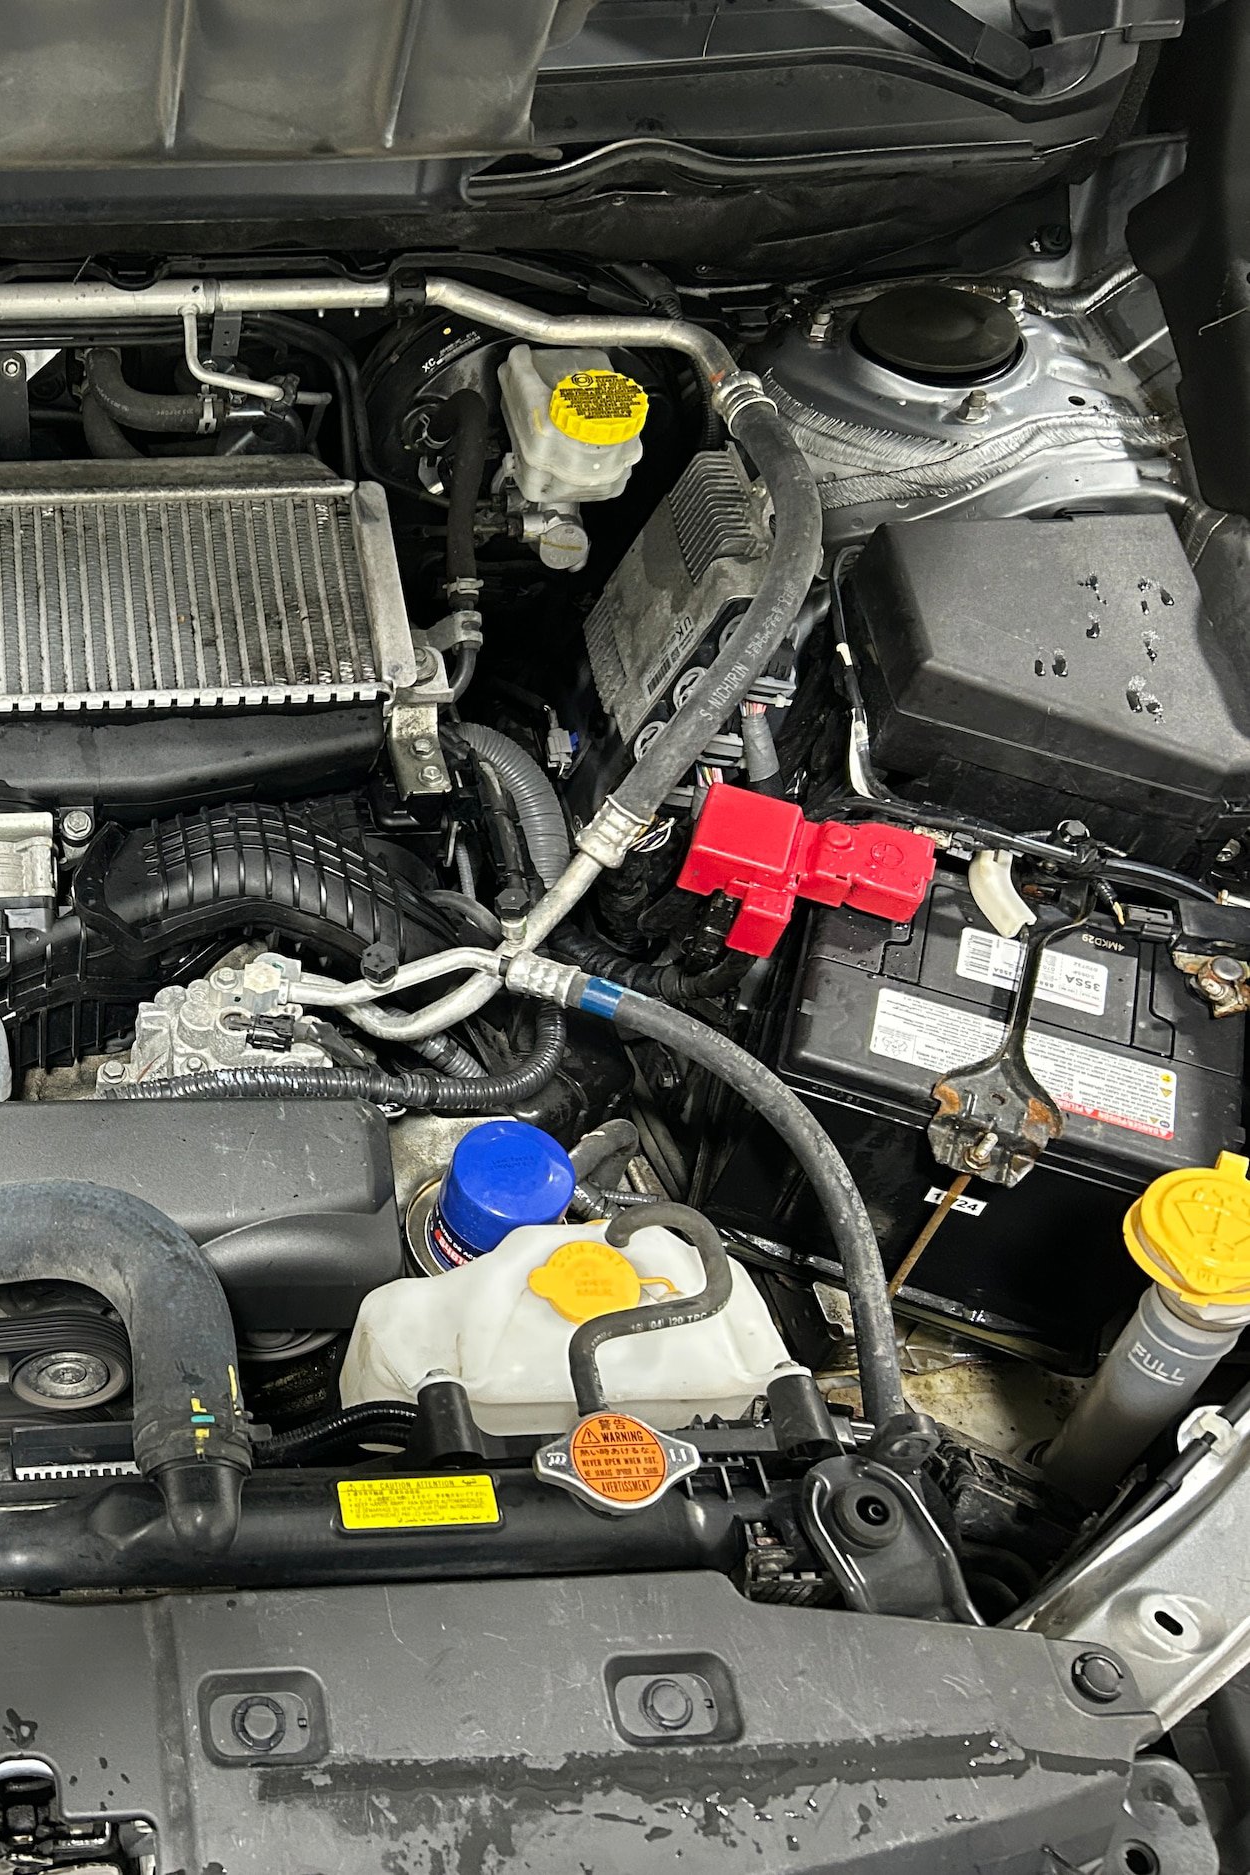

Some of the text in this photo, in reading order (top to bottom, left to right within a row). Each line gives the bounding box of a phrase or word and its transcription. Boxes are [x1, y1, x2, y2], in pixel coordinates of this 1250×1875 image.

[676, 616, 692, 636] UK
[708, 661, 750, 709] NICHIRIN
[1081, 933, 1125, 952] 4MKD29
[1065, 973, 1101, 992] 35SA
[1132, 1341, 1186, 1381] FULL
[598, 1419, 626, 1430] 警告
[600, 1431, 644, 1443] WARNING
[582, 1459, 601, 1467] NEVER
[604, 1458, 622, 1466] OPEN
[624, 1457, 642, 1465] WHEN
[668, 1448, 687, 1462] 1.1
[380, 1480, 455, 1490] CAUTION ATTENTION
[601, 1480, 651, 1493] AVERTISSMENT
